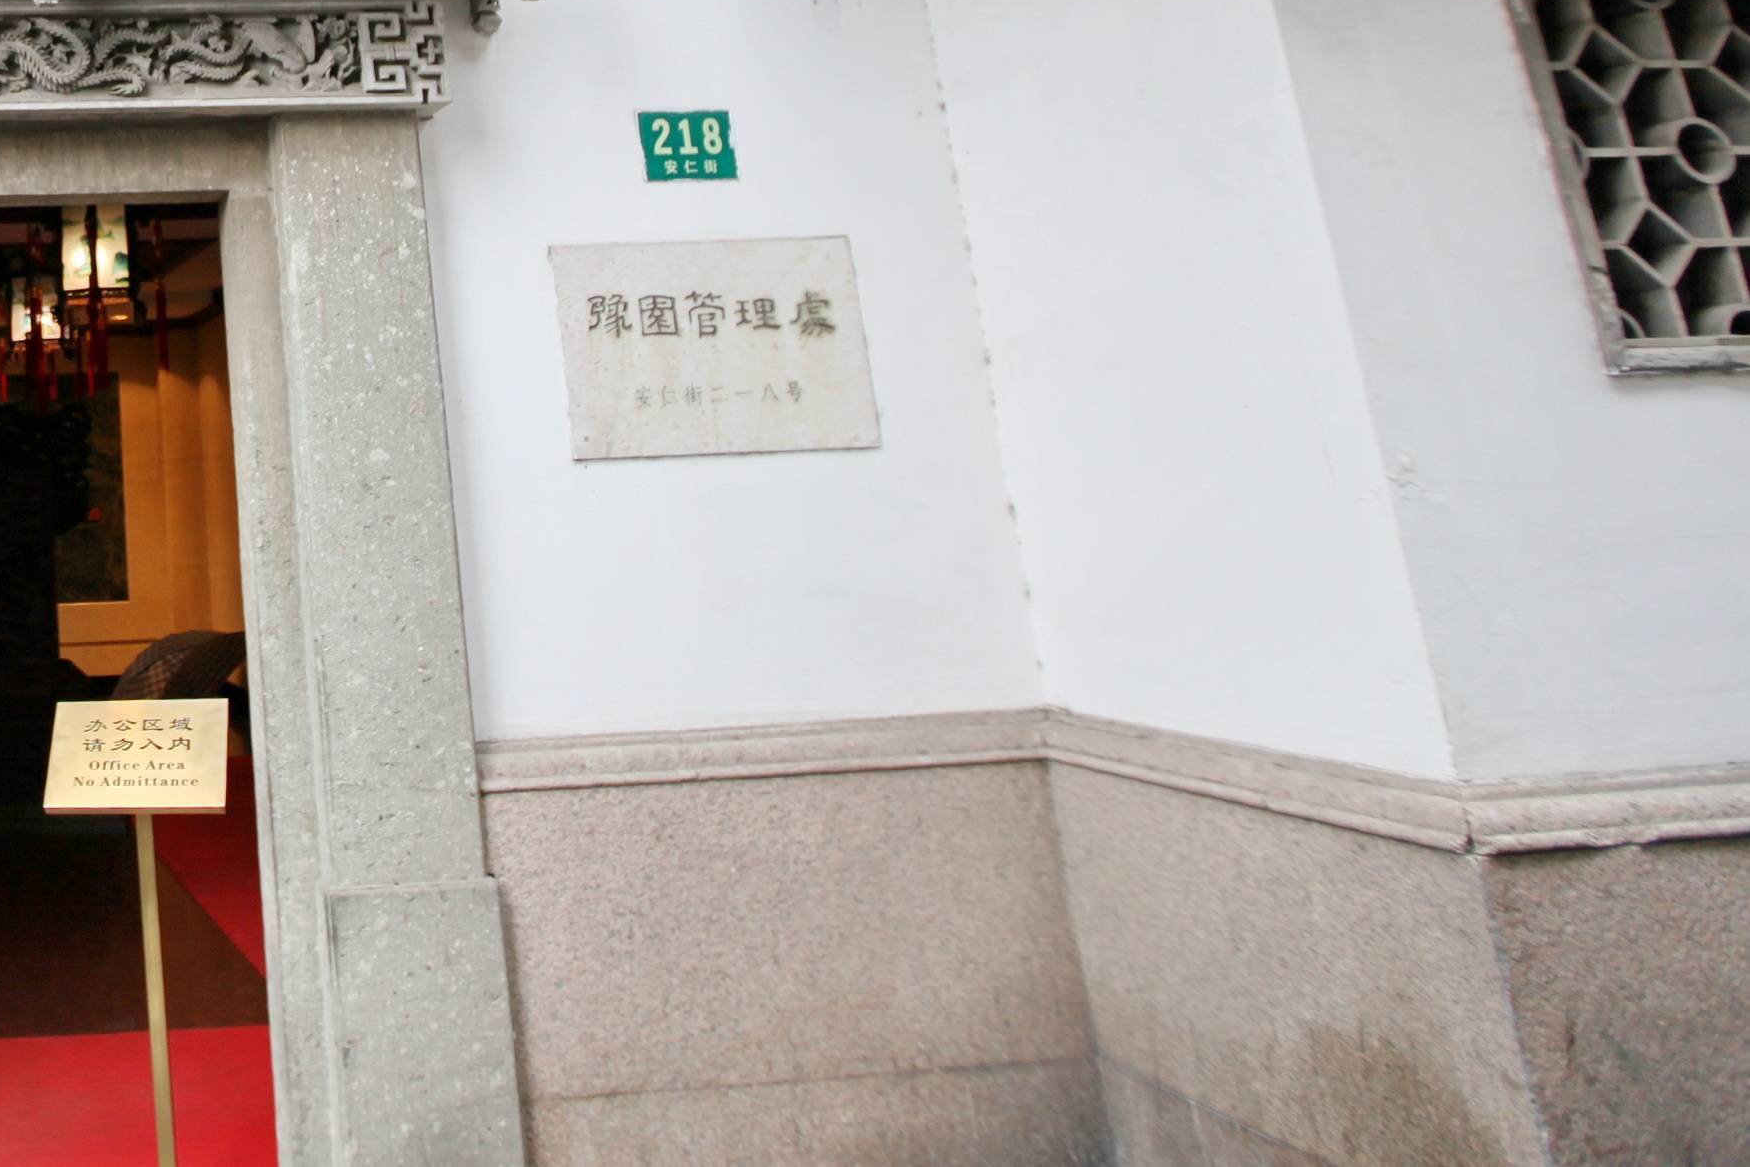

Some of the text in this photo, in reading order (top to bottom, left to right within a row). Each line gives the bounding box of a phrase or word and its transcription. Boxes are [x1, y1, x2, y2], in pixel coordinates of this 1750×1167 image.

[651, 117, 723, 156] 218
[663, 159, 718, 175] 安仁街
[83, 717, 194, 733] 办公区域
[82, 737, 193, 752] 请勿入内
[89, 760, 185, 771] Office Area
[73, 776, 200, 787] No Admittance
